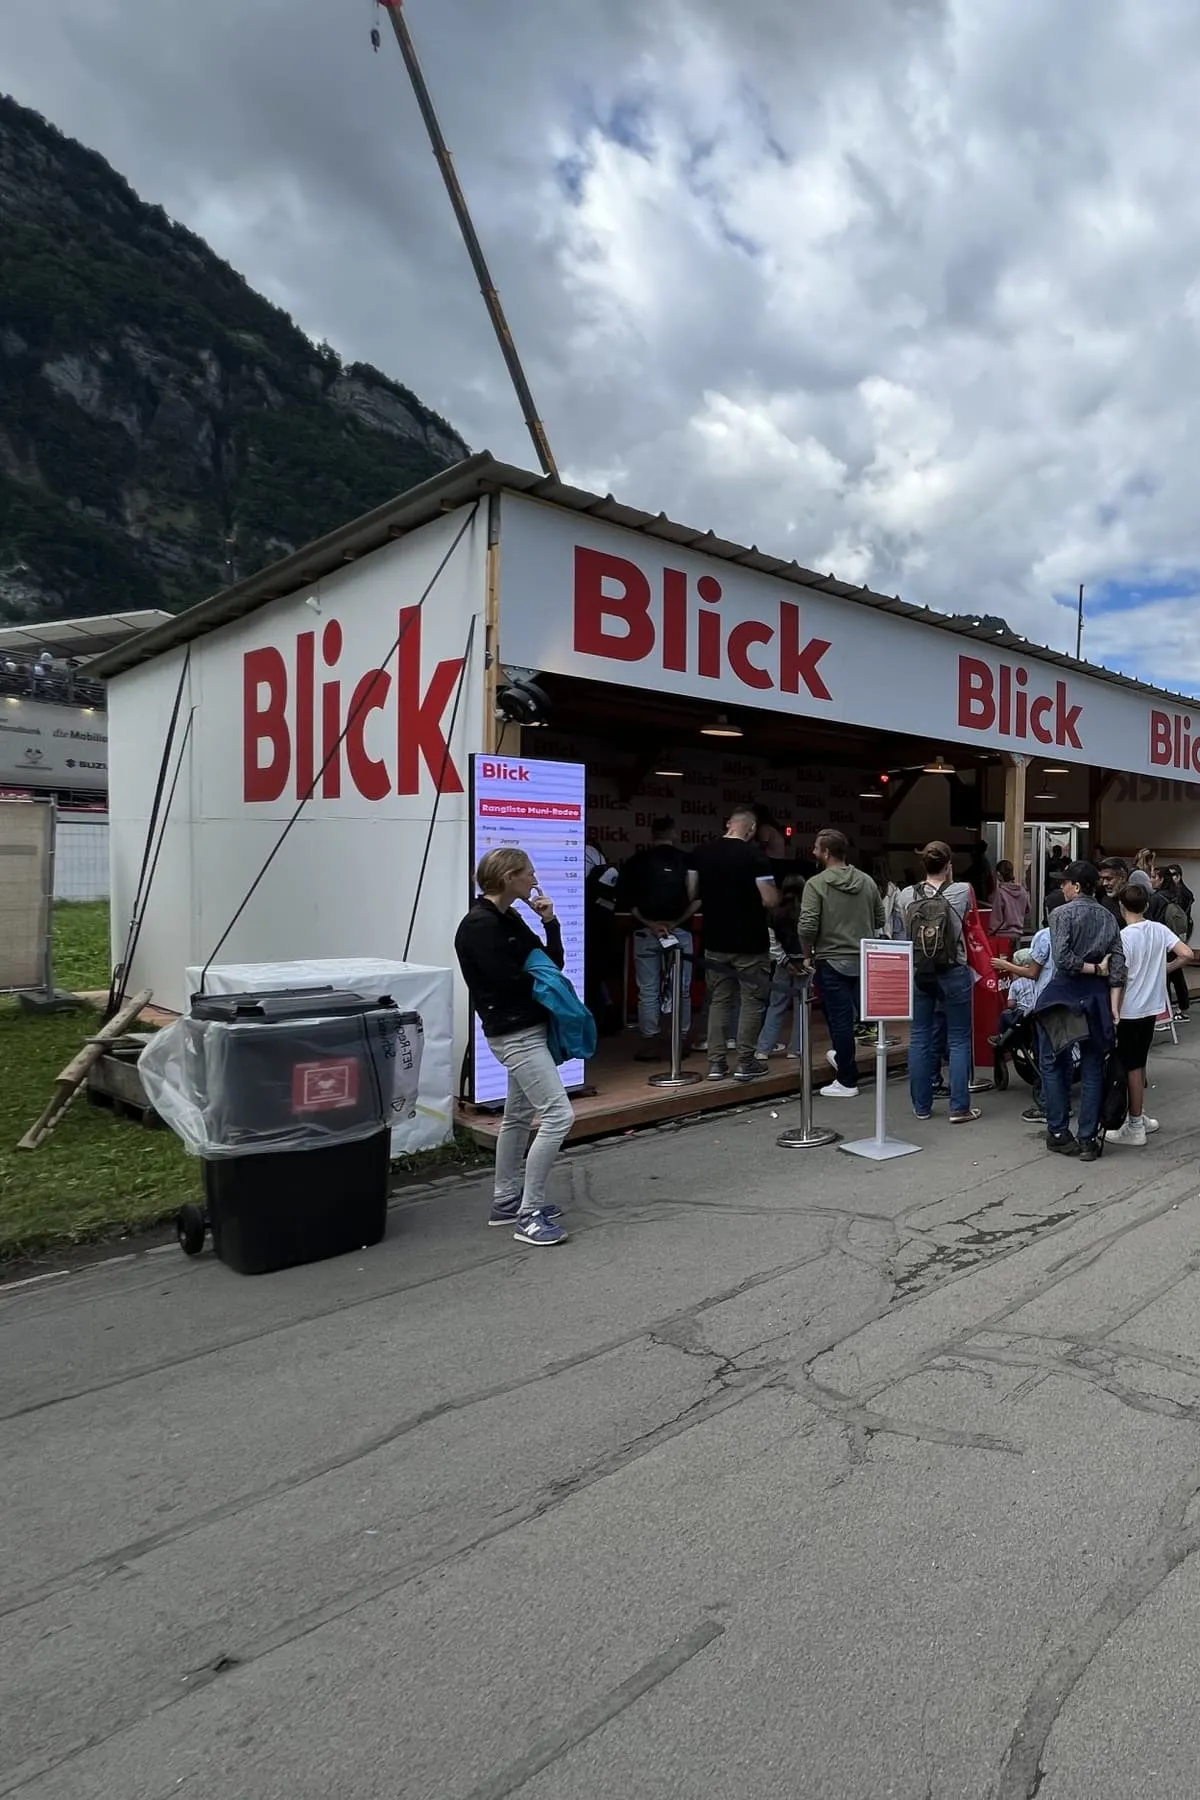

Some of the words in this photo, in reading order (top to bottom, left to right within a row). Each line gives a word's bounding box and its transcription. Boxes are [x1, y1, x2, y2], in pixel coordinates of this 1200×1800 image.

[574, 545, 833, 700] Blick
[243, 604, 465, 802] Blick
[958, 655, 1083, 749] Blick
[482, 763, 530, 781] Blick
[482, 804, 526, 814] Rangliste
[527, 807, 579, 816] Muni-Rodeo
[681, 800, 717, 815] Blick
[588, 826, 629, 842] Blick
